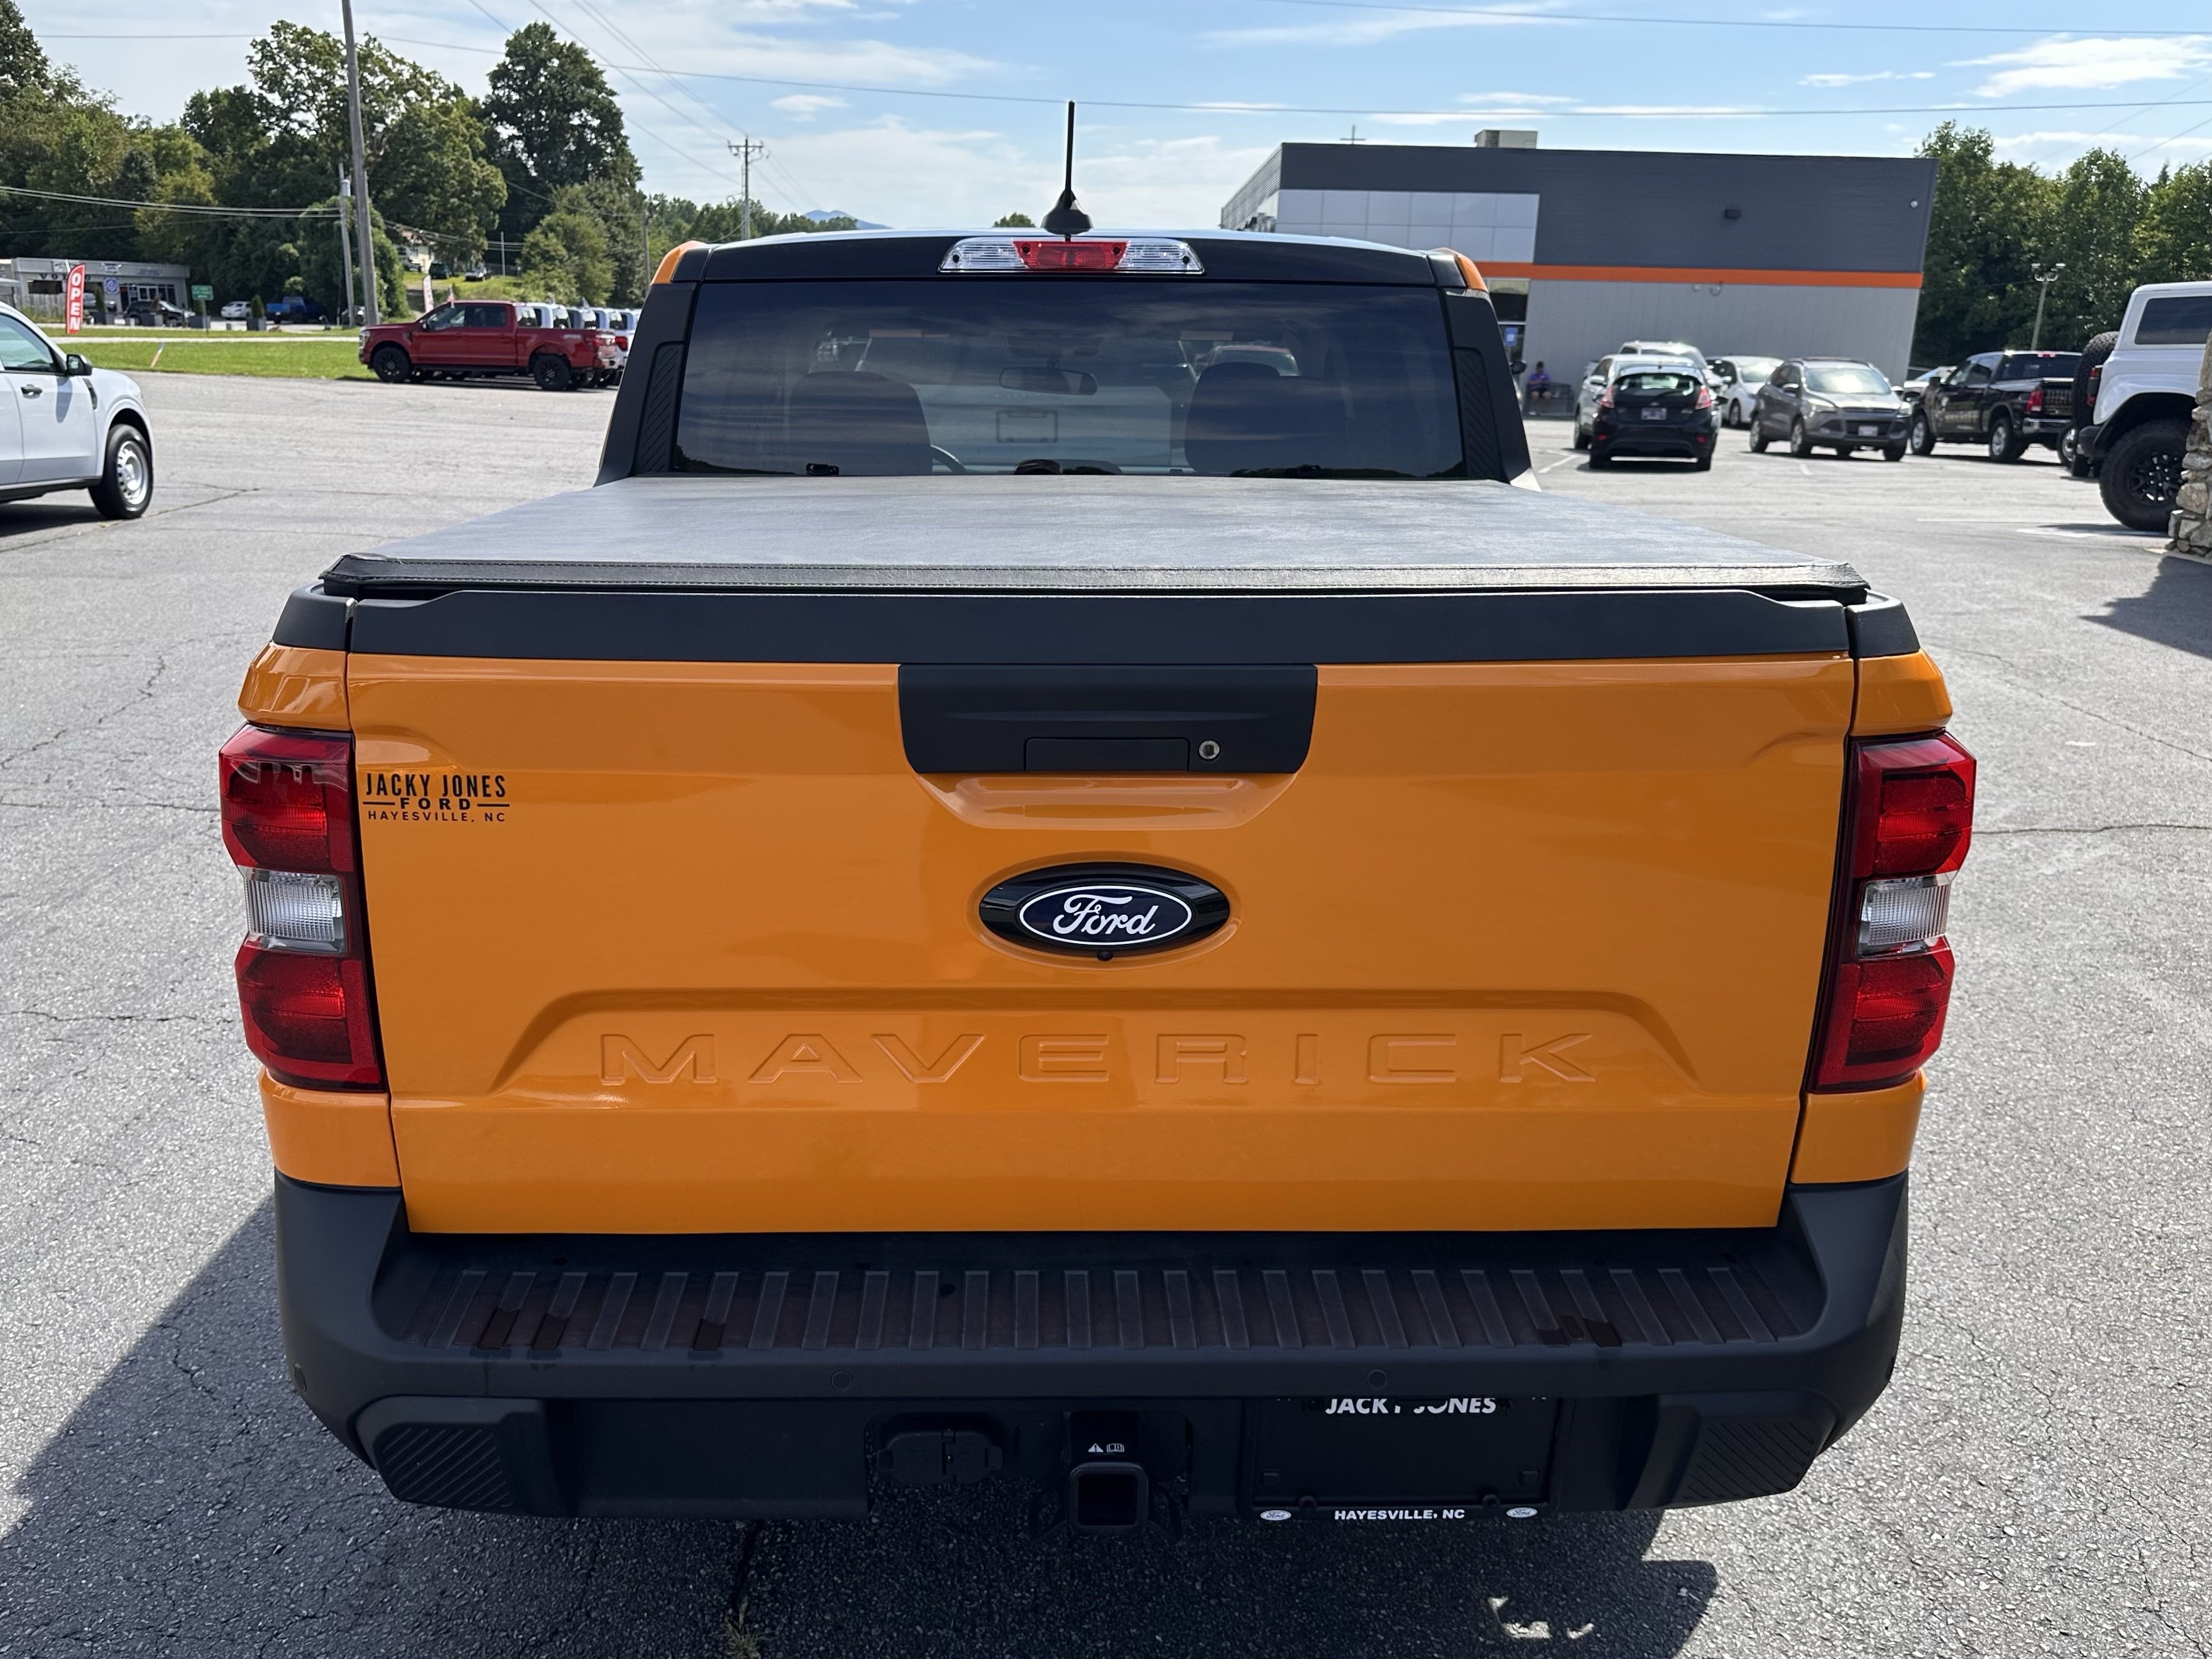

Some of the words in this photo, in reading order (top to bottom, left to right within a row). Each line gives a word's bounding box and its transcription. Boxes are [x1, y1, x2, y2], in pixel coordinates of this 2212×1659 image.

[70, 272, 81, 331] OPEN
[366, 773, 430, 797] JACKY
[442, 774, 506, 797] JONES
[400, 797, 471, 810] FORD
[368, 811, 474, 823] HAYESVILLE,
[485, 813, 505, 821] NC
[1053, 894, 1159, 934] Ford
[601, 1033, 1597, 1085] MAVERICK
[1335, 1509, 1437, 1520] HAYESVILLE,
[1443, 1509, 1465, 1519] NC
